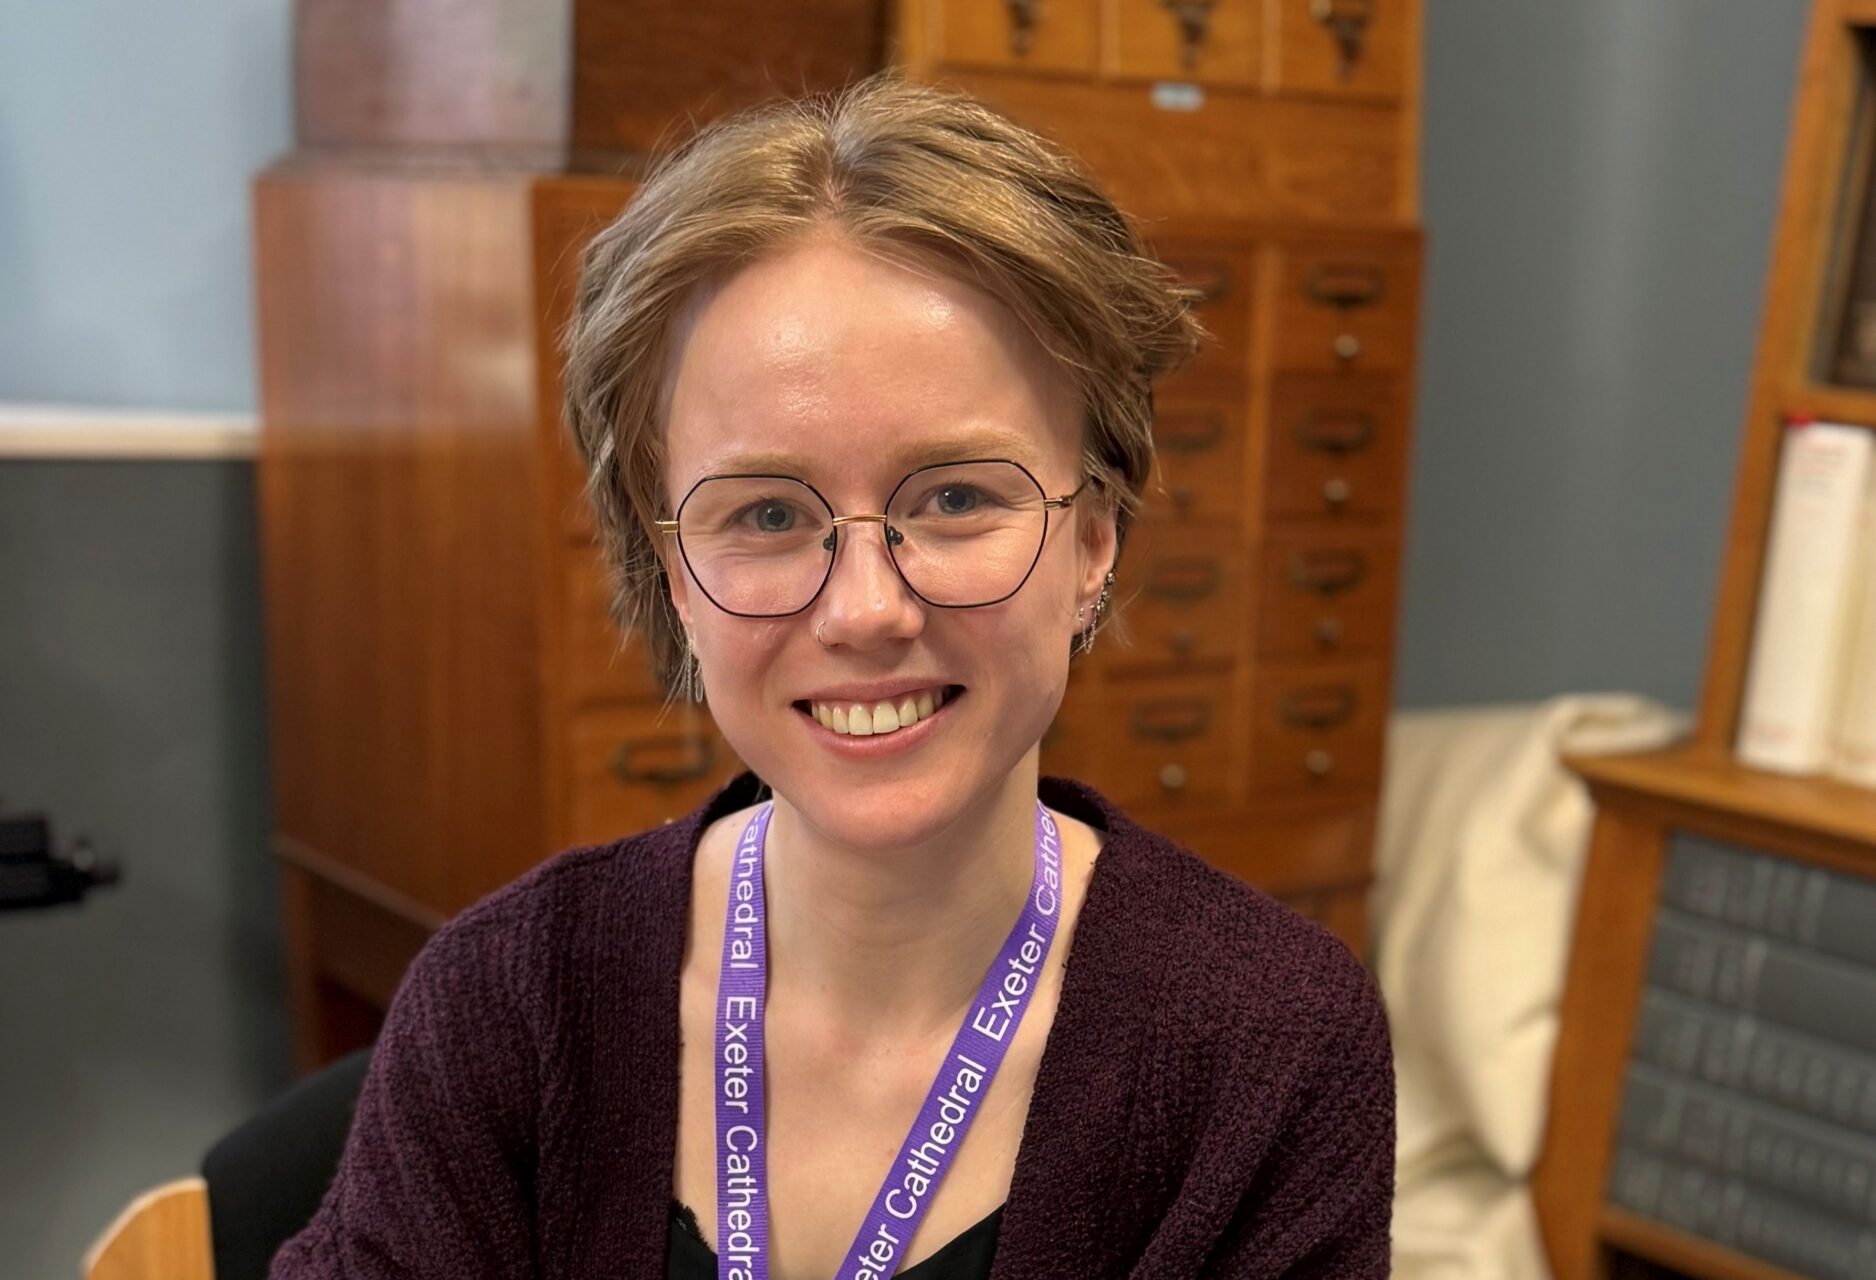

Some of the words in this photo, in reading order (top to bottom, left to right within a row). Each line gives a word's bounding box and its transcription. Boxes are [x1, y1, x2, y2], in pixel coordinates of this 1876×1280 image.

[724, 997, 756, 1114] Exeter
[885, 1054, 987, 1220] Cathedral
[972, 923, 1047, 1042] Exeter
